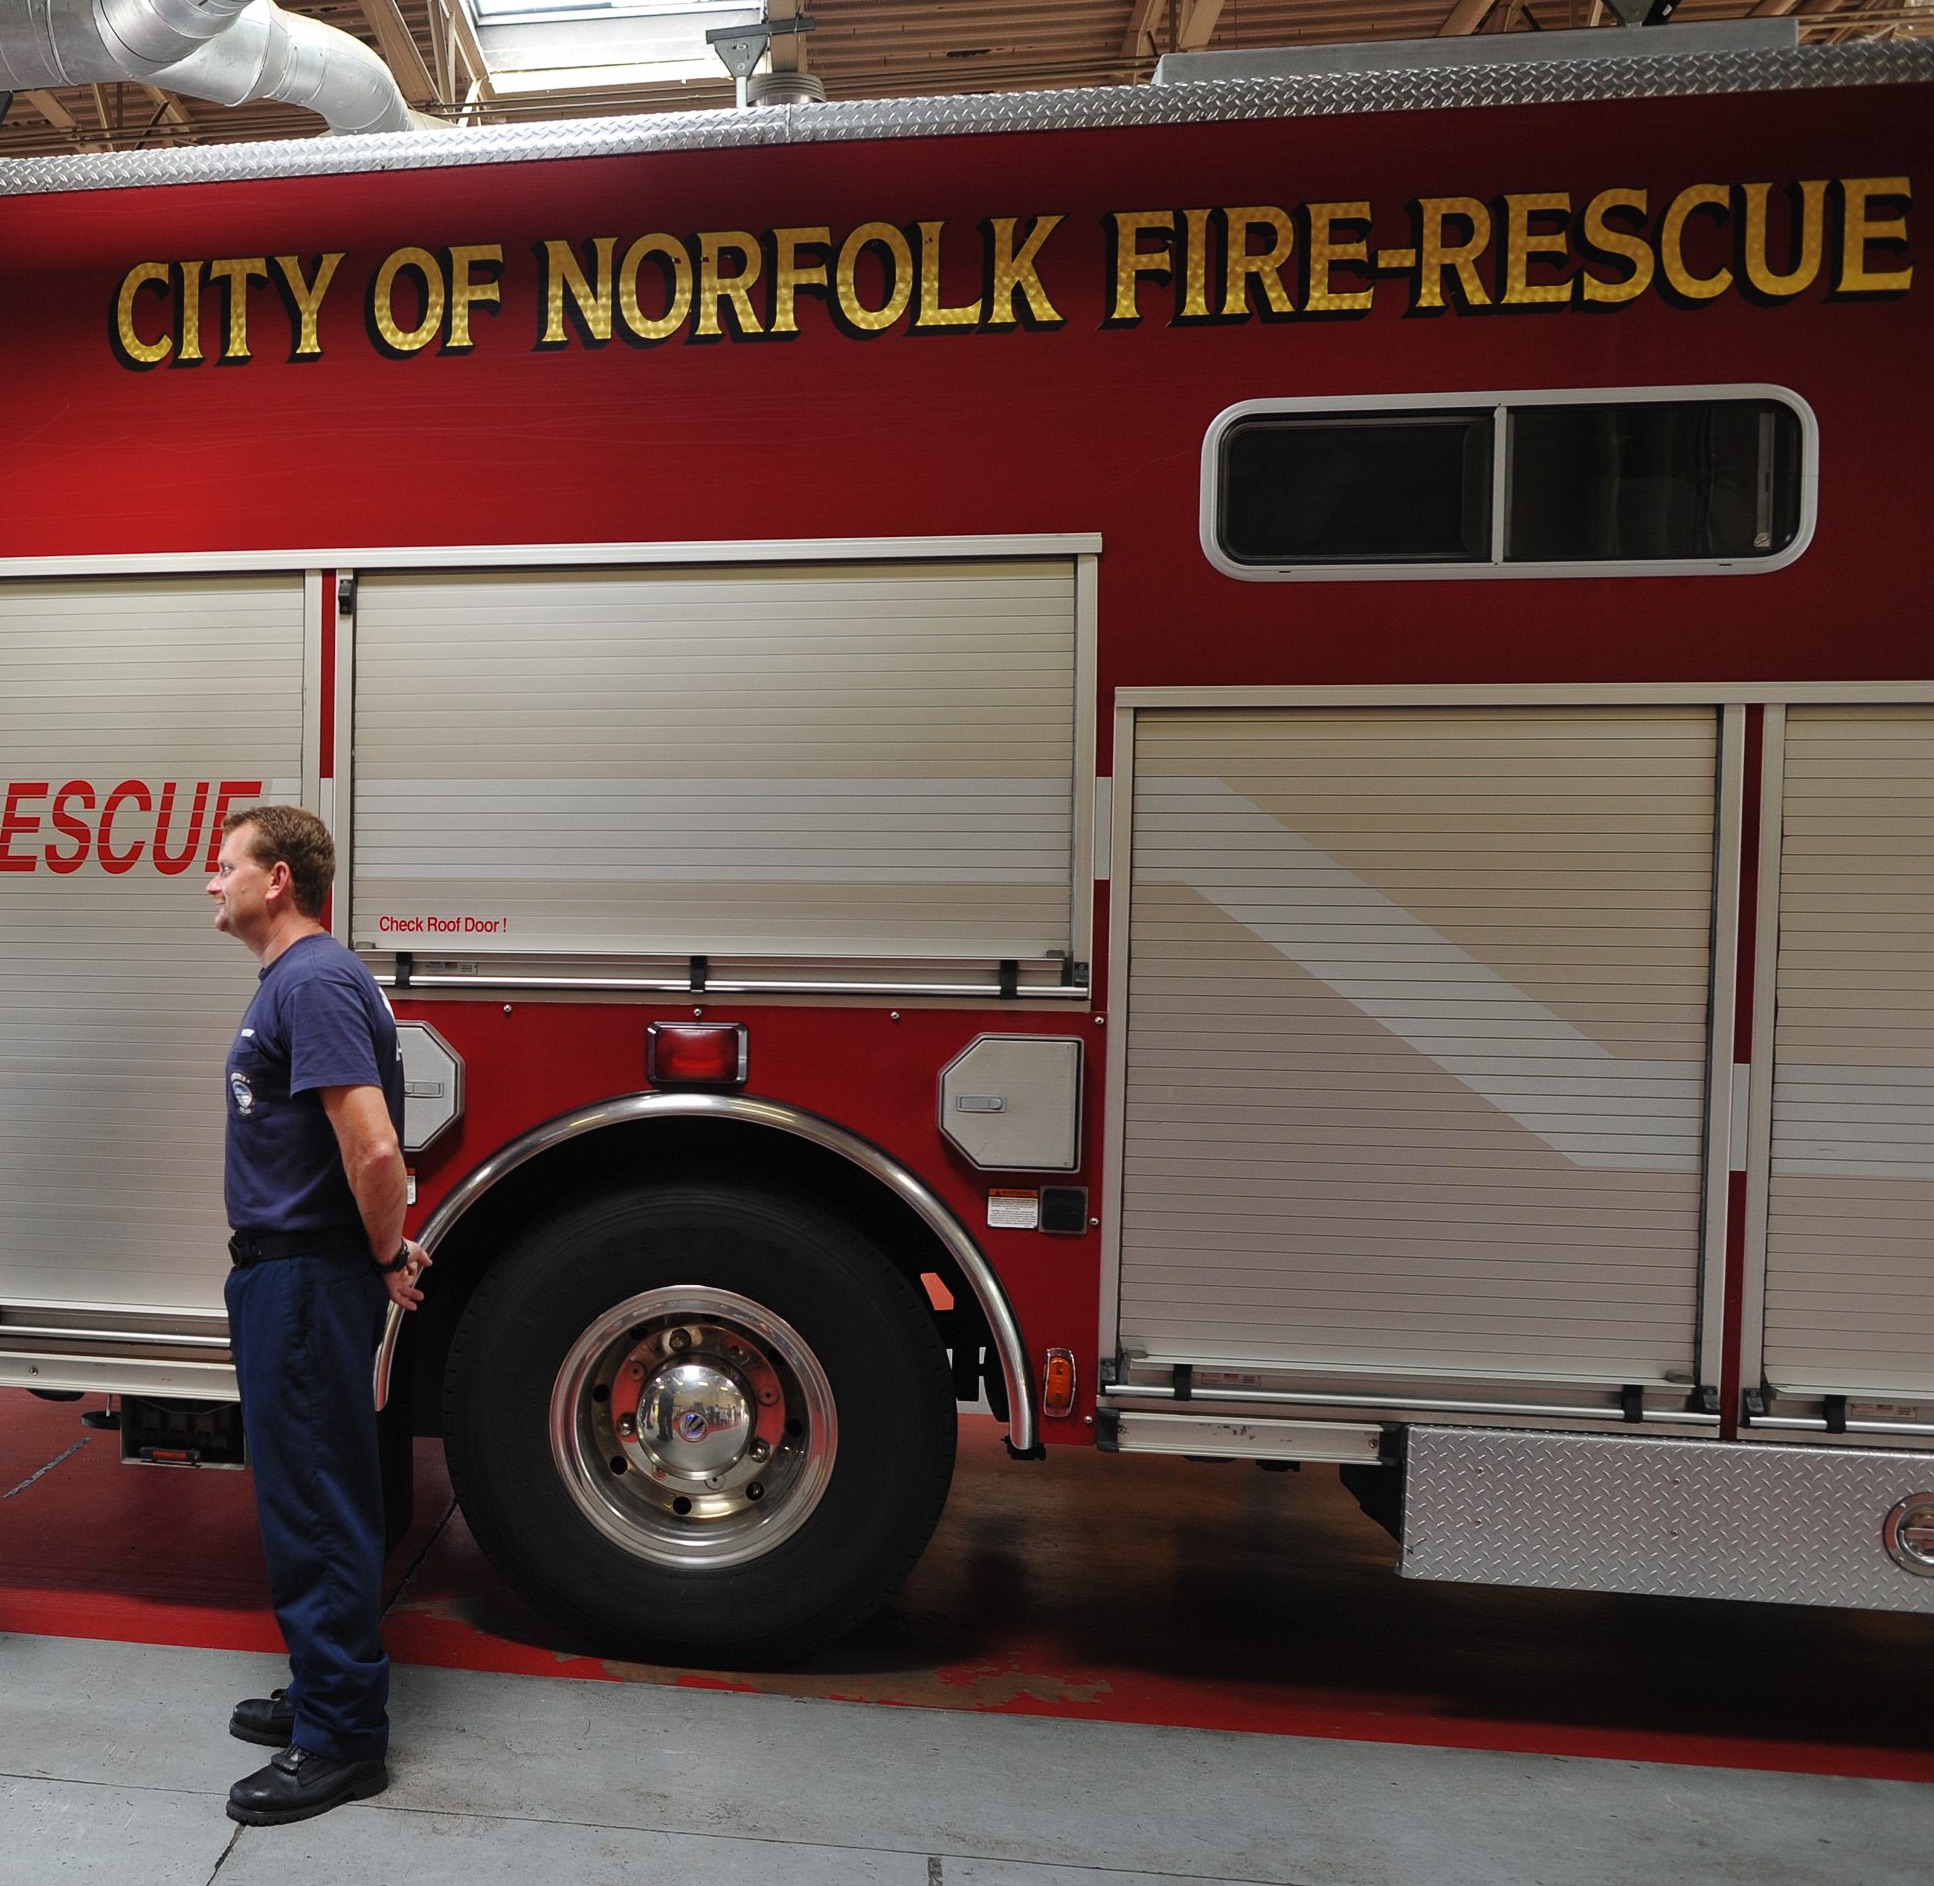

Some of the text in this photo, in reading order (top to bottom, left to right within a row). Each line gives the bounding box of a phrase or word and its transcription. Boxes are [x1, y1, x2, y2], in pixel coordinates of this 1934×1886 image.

[117, 177, 1913, 362] CITY OF NORFOLK FIRE-RESCUE
[379, 916, 423, 932] Check
[427, 916, 462, 933] Roof
